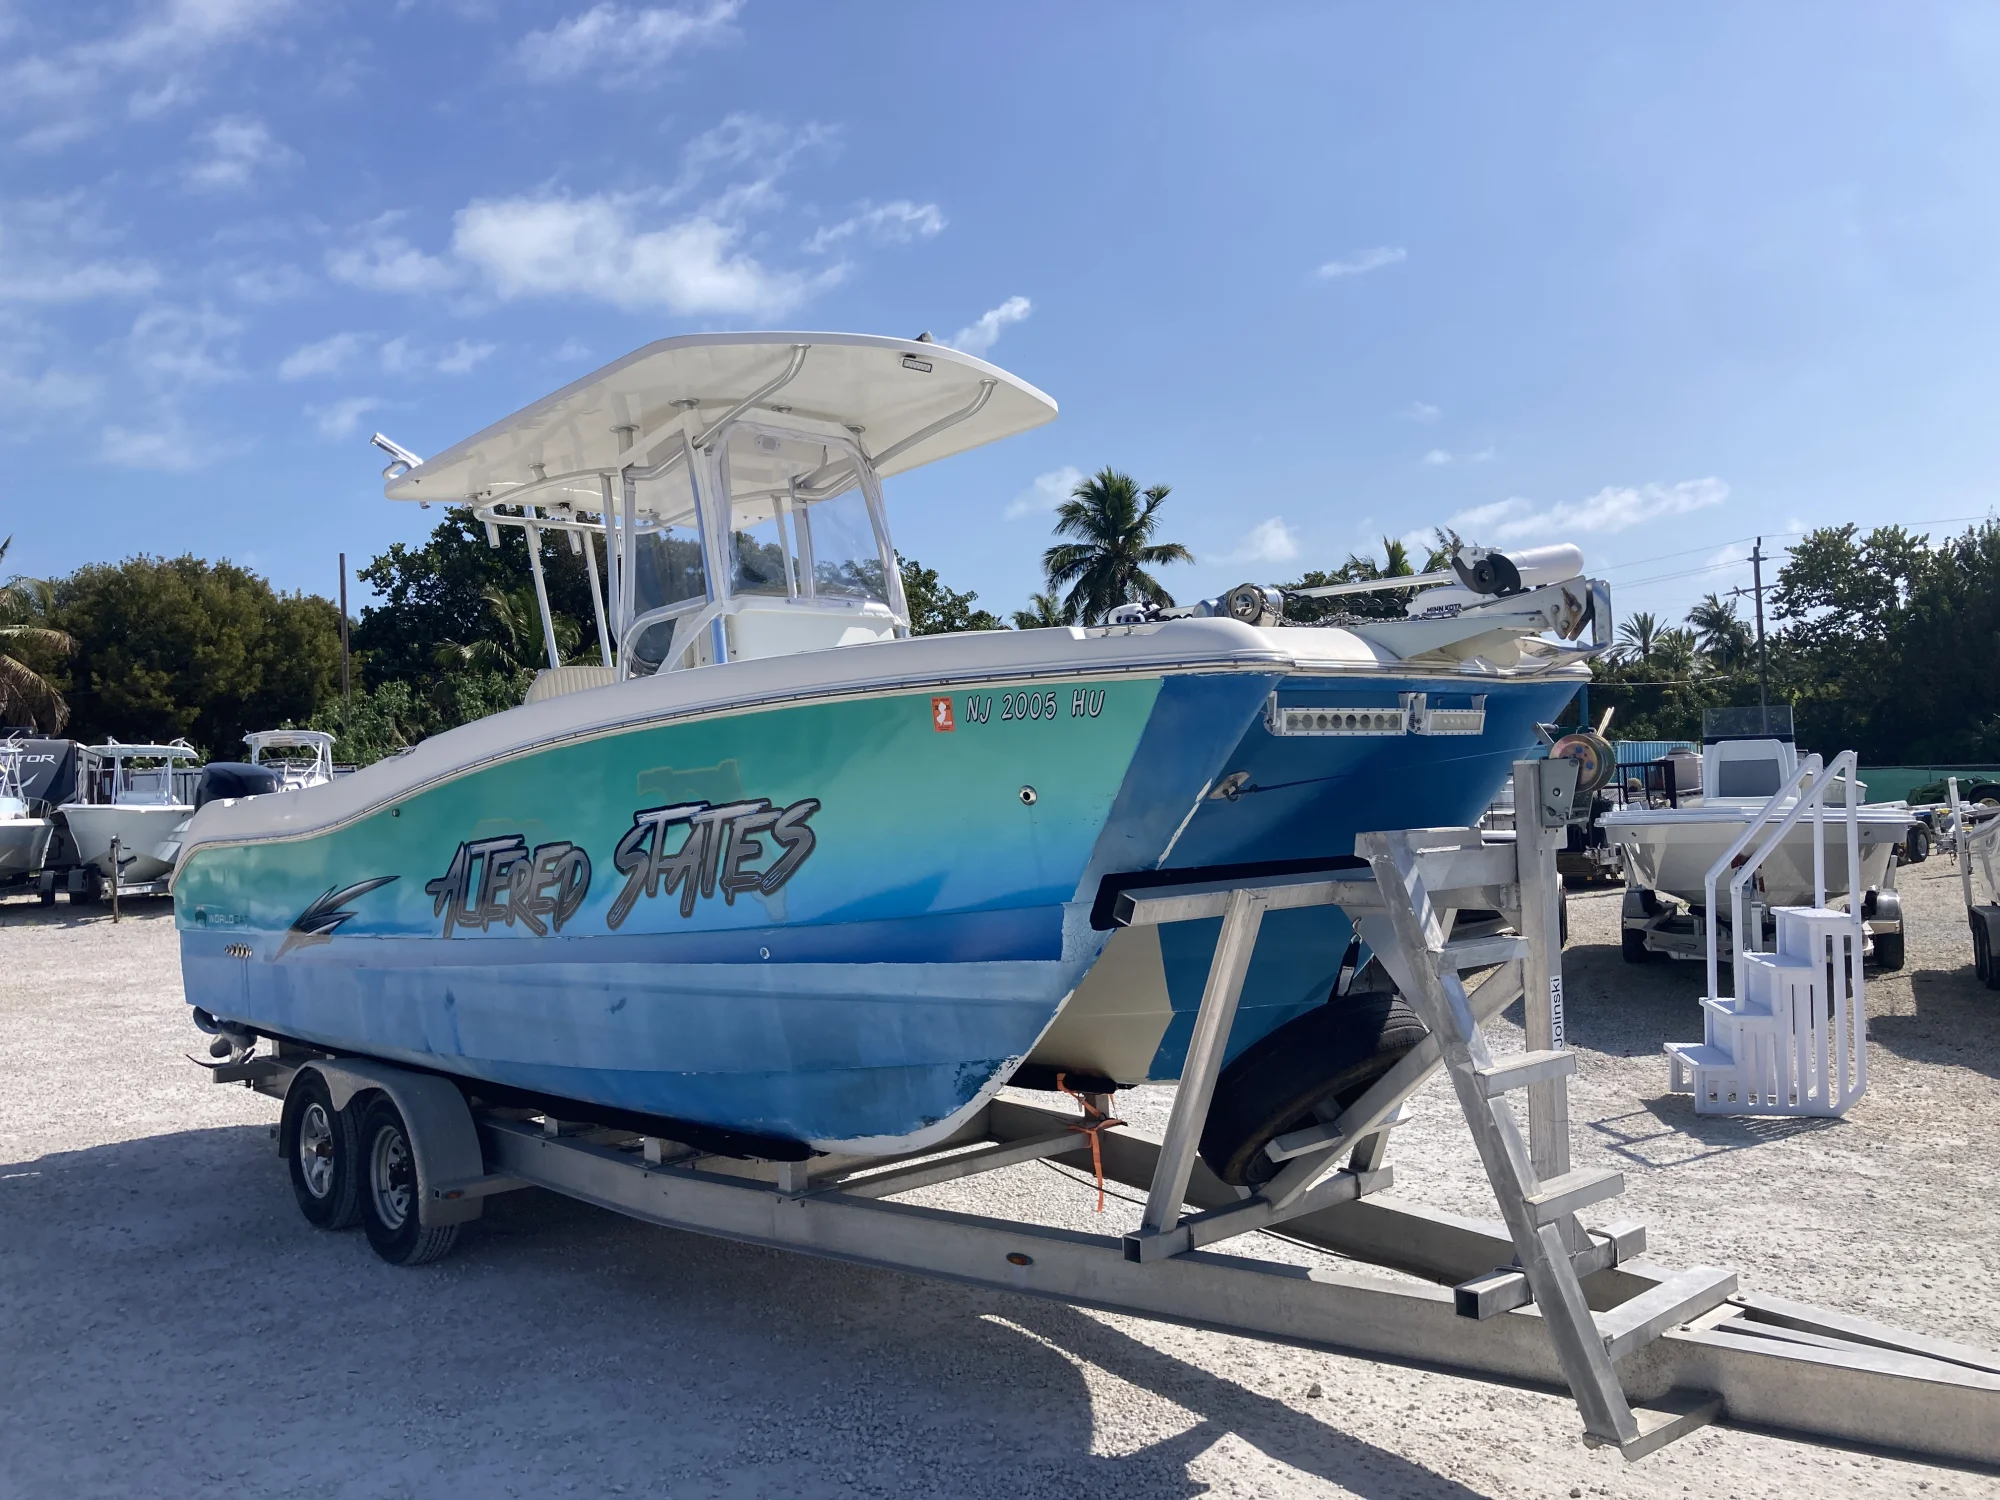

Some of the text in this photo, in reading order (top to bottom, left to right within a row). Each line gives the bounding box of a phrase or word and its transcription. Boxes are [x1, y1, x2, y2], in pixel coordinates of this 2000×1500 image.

[1426, 603, 1462, 613] MINN KOTA
[966, 688, 1105, 724] NJ 2005 HU
[18, 755, 57, 765] TOR
[425, 797, 821, 940] ALTERED STATES
[1550, 978, 1563, 1048] Jolinski
